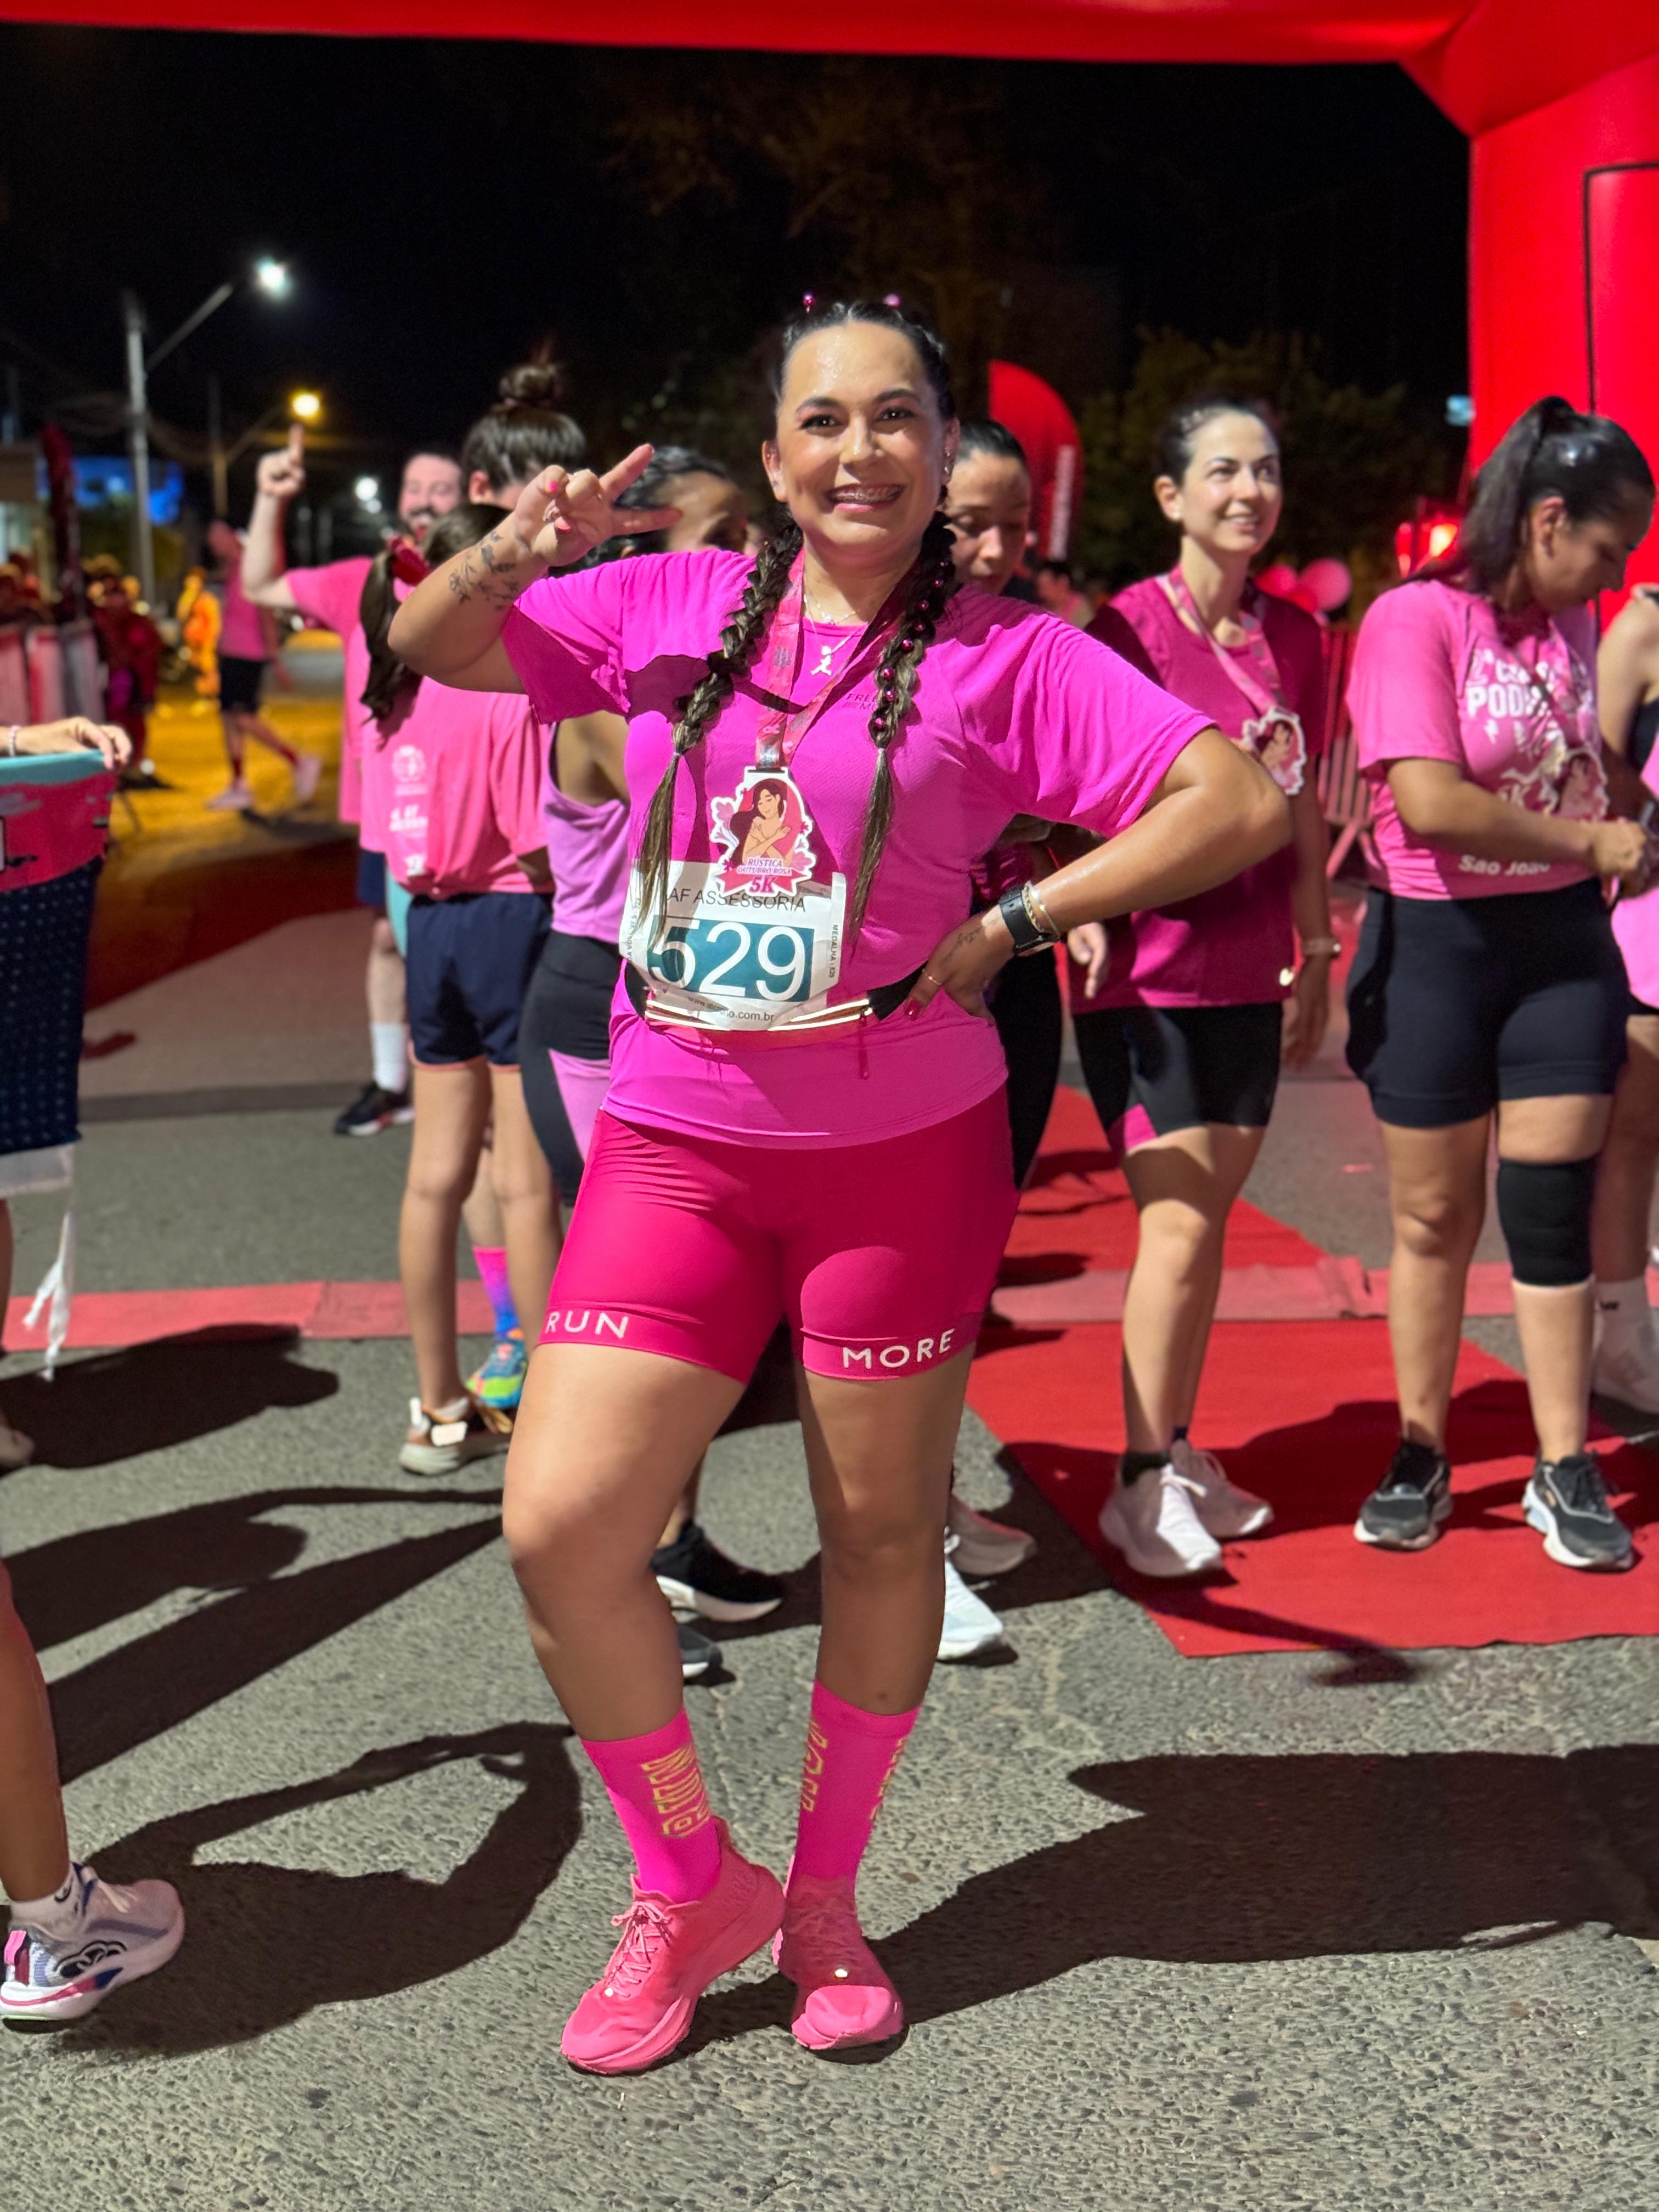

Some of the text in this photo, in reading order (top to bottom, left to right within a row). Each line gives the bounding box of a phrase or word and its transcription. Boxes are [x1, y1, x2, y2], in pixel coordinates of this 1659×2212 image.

[748, 857, 782, 867] RÚSTICA
[749, 875, 777, 893] 5K
[693, 889, 806, 913] ASSESSORIA
[830, 924, 838, 961] MEDALHA
[651, 919, 805, 1001] 529
[544, 1310, 629, 1339] RUN
[842, 1328, 955, 1369] MORE
